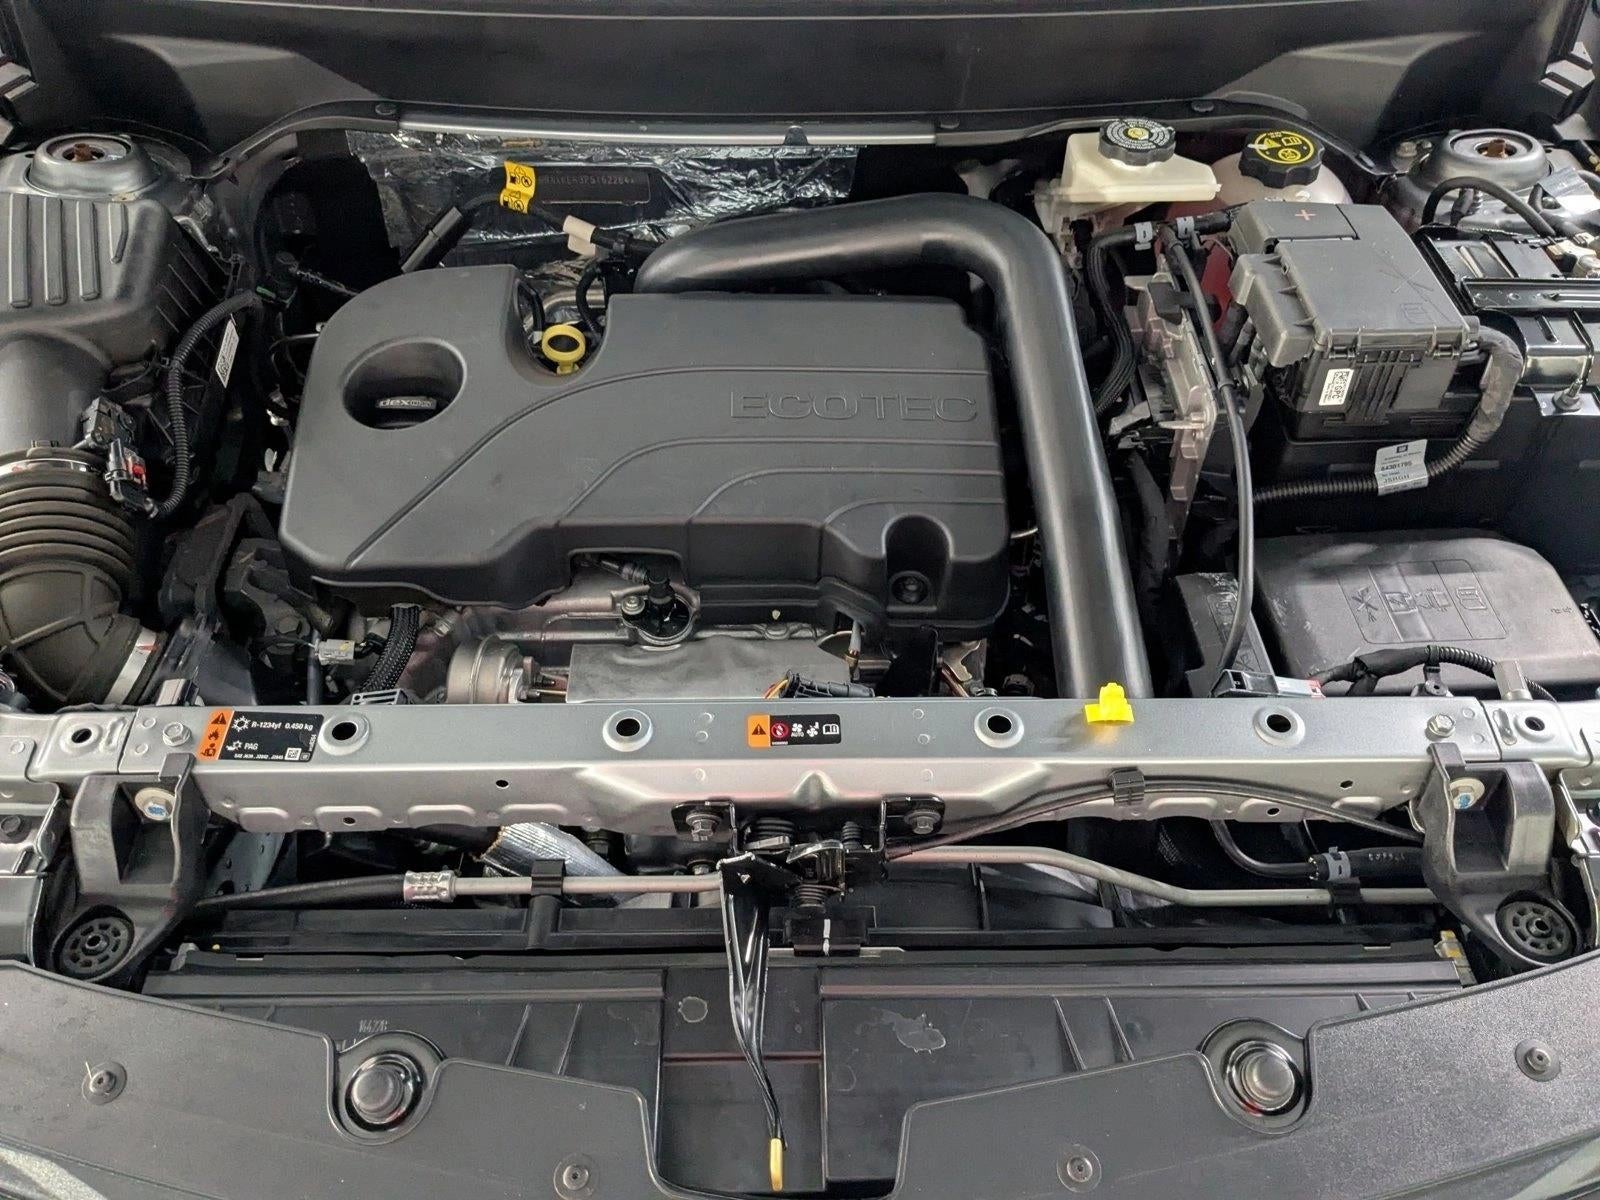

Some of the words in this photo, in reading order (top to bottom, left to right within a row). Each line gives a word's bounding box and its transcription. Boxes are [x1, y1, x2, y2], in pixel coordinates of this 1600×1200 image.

[730, 392, 977, 422] ECOTEC
[251, 721, 281, 729] R-1234yf
[285, 722, 303, 730] 0.450
[304, 723, 313, 731] kg
[244, 742, 258, 750] PAG
